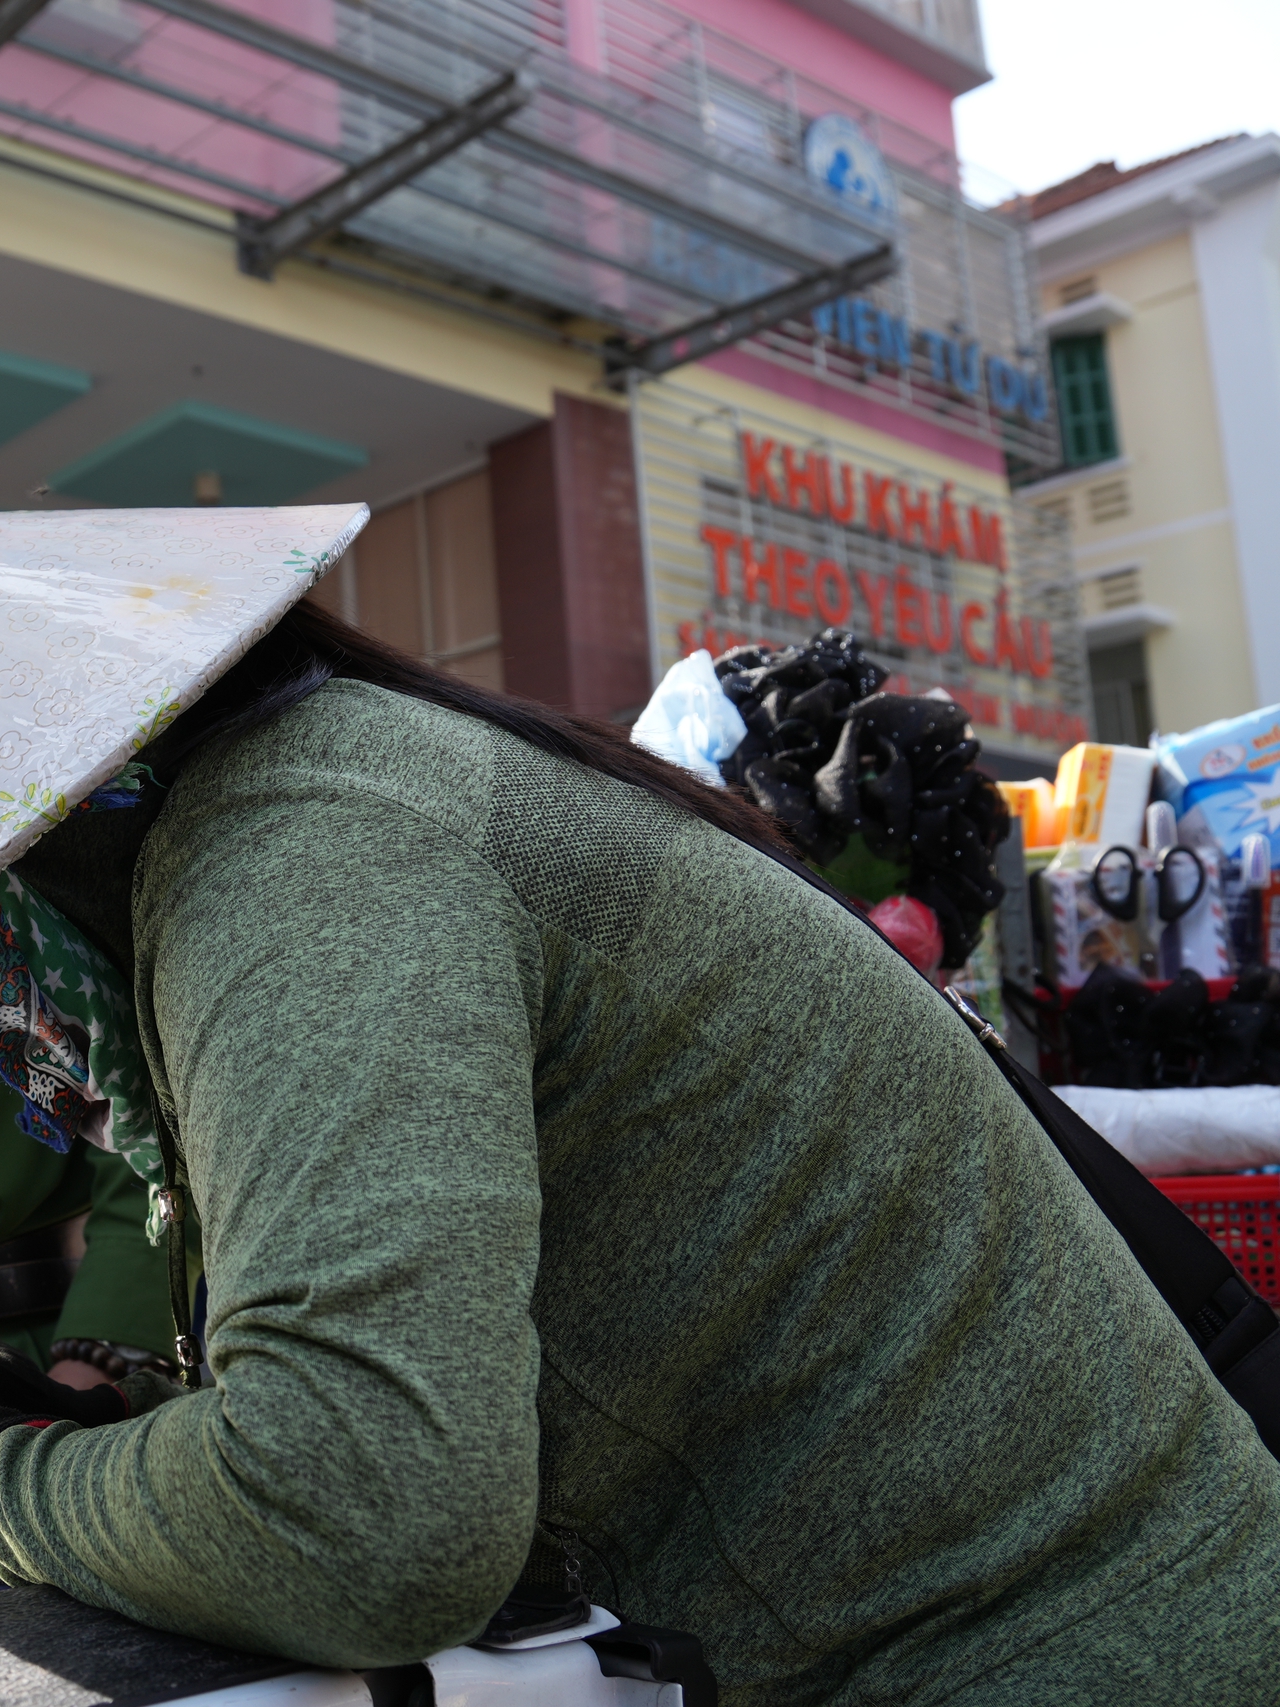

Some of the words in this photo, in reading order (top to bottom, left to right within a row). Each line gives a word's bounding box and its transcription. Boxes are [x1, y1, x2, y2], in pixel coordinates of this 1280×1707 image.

[741, 430, 856, 525] KHU
[864, 480, 1009, 573] KHÁM
[701, 524, 854, 627] THEO
[857, 564, 953, 654] YÊU
